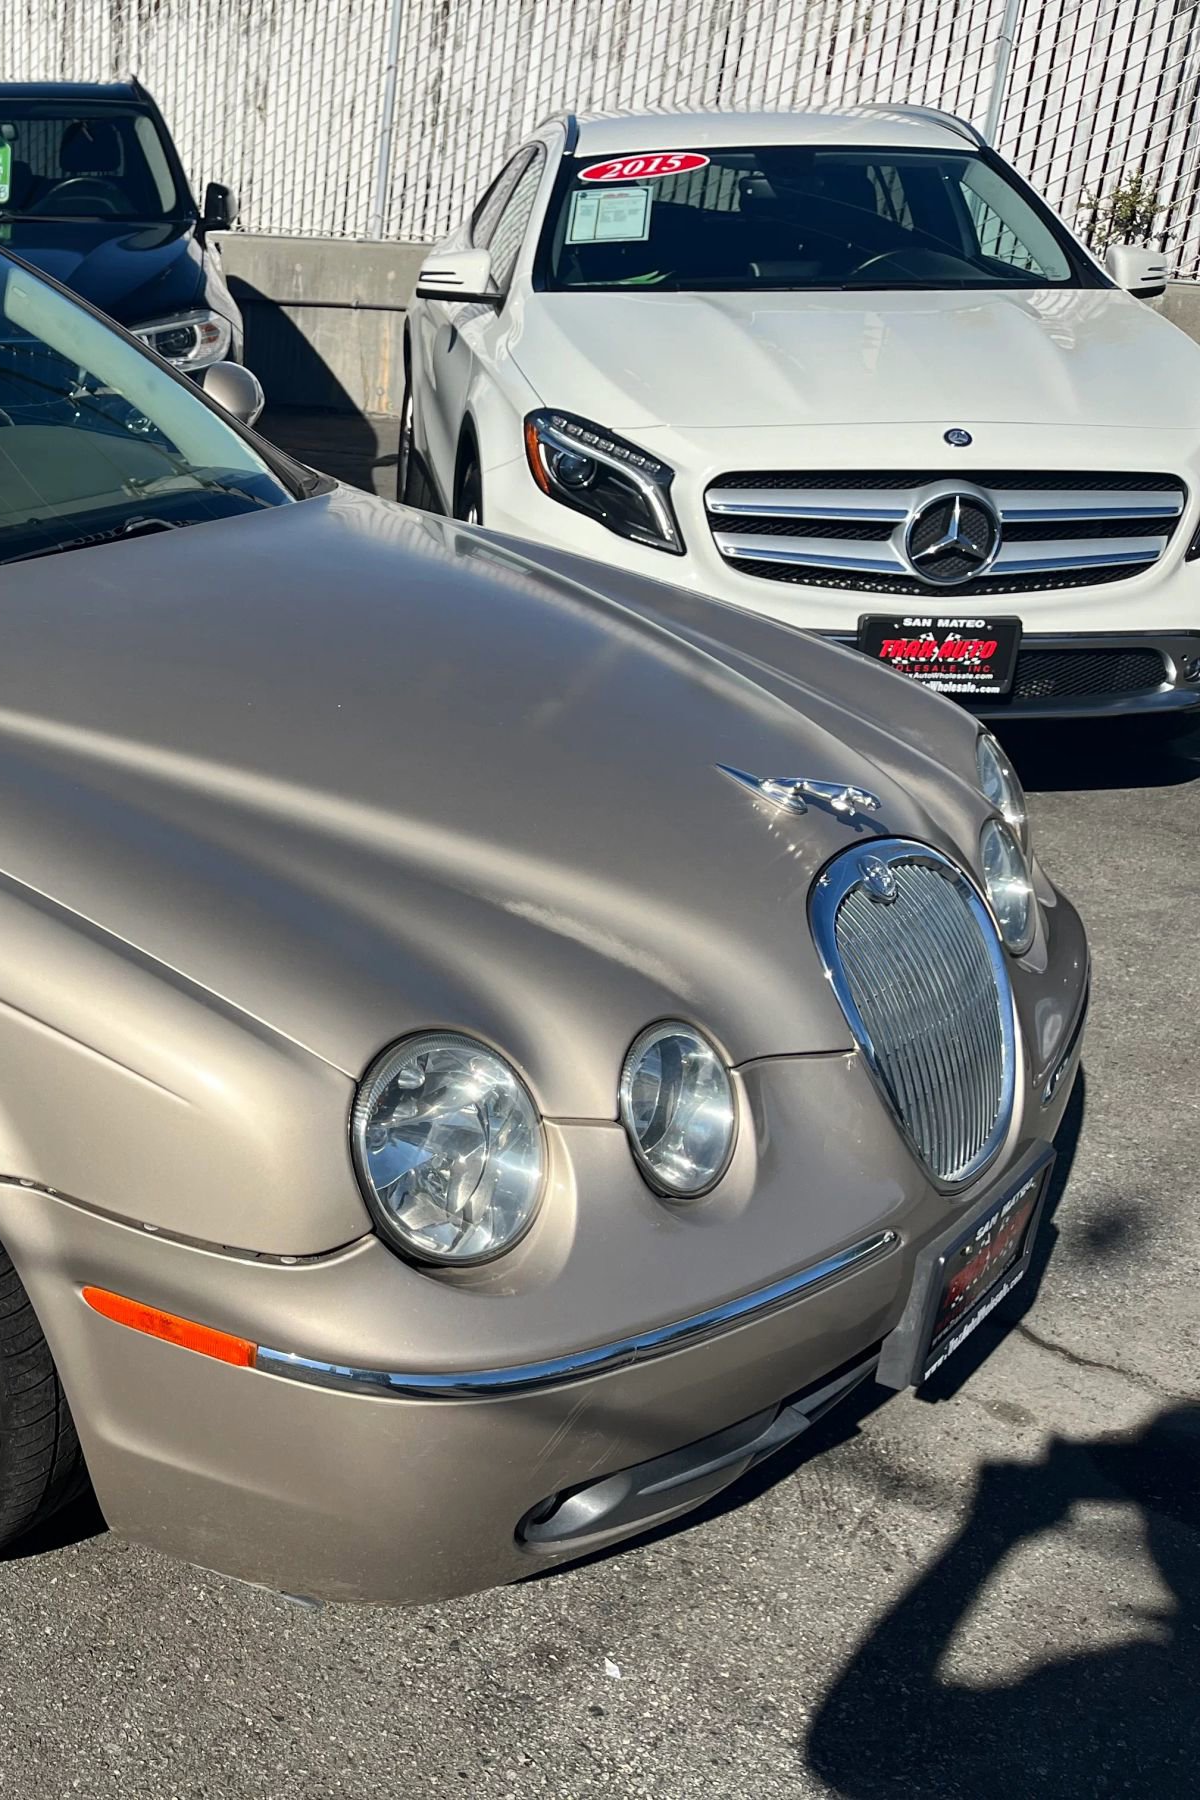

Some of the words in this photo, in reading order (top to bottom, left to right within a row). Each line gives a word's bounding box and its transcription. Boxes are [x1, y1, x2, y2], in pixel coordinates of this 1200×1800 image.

[601, 155, 686, 178] 2015
[903, 618, 932, 627] SAN
[937, 619, 986, 628] MATEO
[880, 639, 938, 657] TRAX
[938, 640, 998, 659] AUTO
